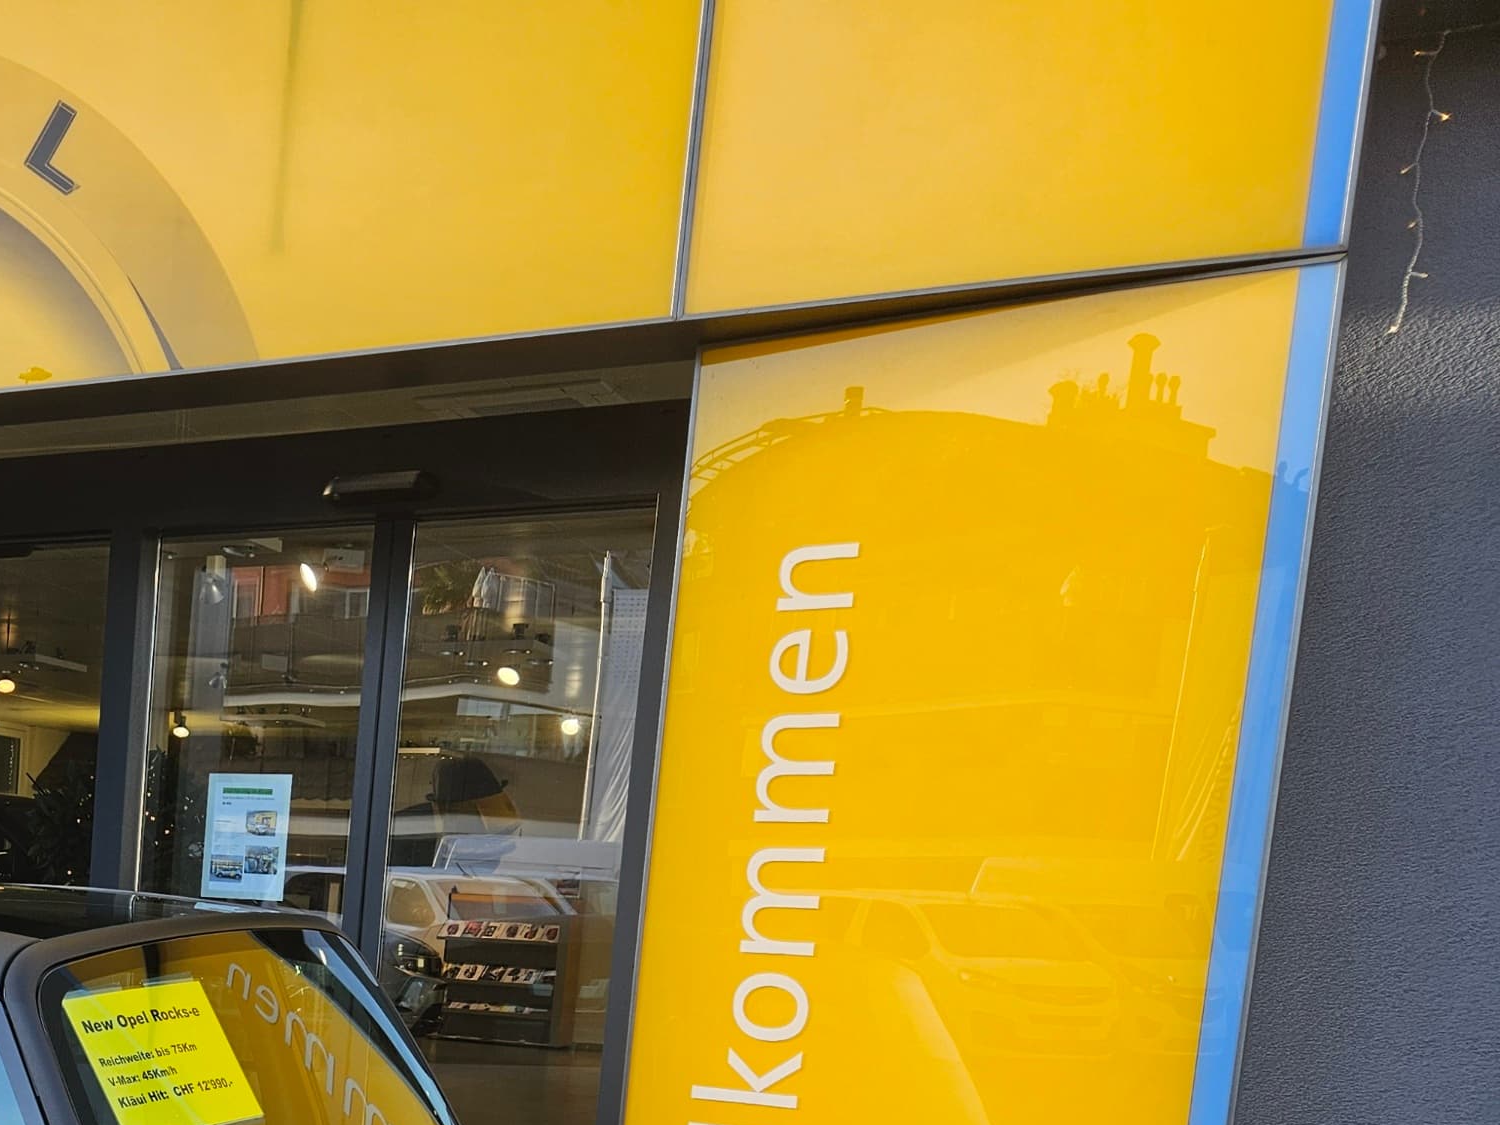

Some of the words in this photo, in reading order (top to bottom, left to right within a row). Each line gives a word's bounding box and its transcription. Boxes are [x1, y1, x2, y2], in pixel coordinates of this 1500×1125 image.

[81, 1019, 114, 1034] New
[116, 1010, 149, 1030] Opel
[150, 1006, 201, 1023] Rocks-e
[98, 1050, 155, 1067] Reichweite:
[155, 1047, 171, 1058] bis
[171, 1042, 198, 1054] 75Km
[108, 1074, 141, 1087] V-Max:
[142, 1066, 178, 1081] 45Km/h
[118, 1093, 148, 1109] Kläui
[148, 1090, 170, 1102] Hit:
[173, 1083, 195, 1097] CHF
